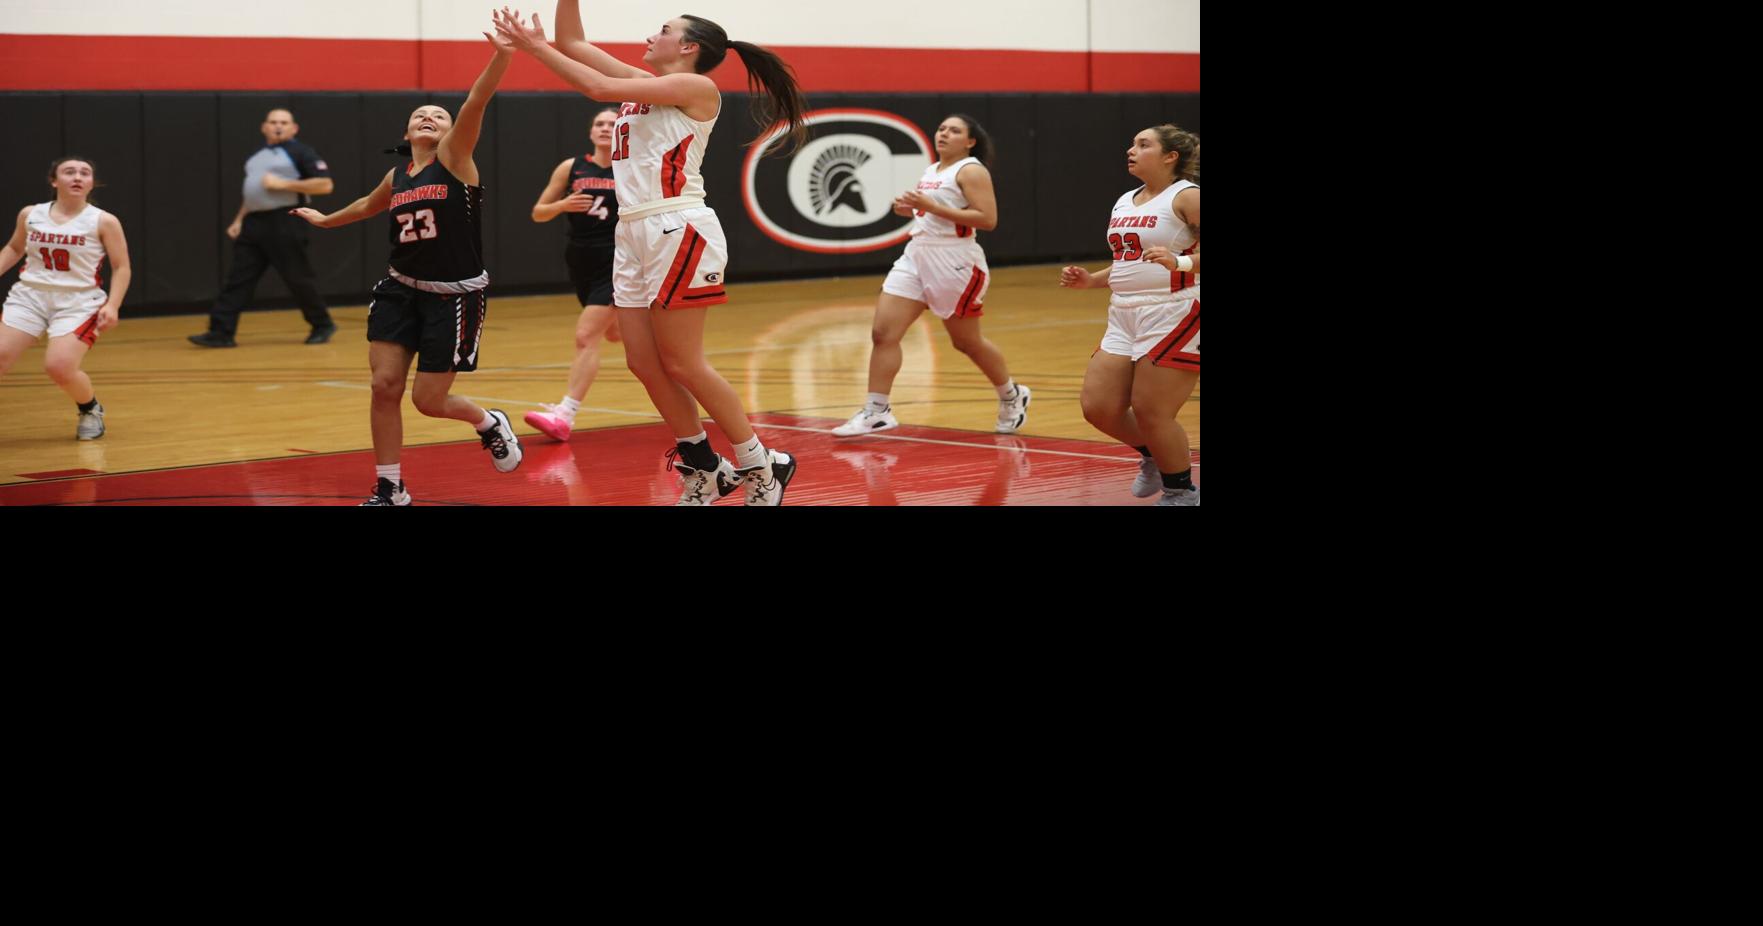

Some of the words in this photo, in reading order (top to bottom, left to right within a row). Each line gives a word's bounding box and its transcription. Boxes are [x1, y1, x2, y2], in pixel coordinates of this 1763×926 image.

[587, 195, 609, 220] 4
[29, 231, 87, 246] SPARTANS
[395, 208, 438, 244] 23
[39, 246, 71, 272] 10
